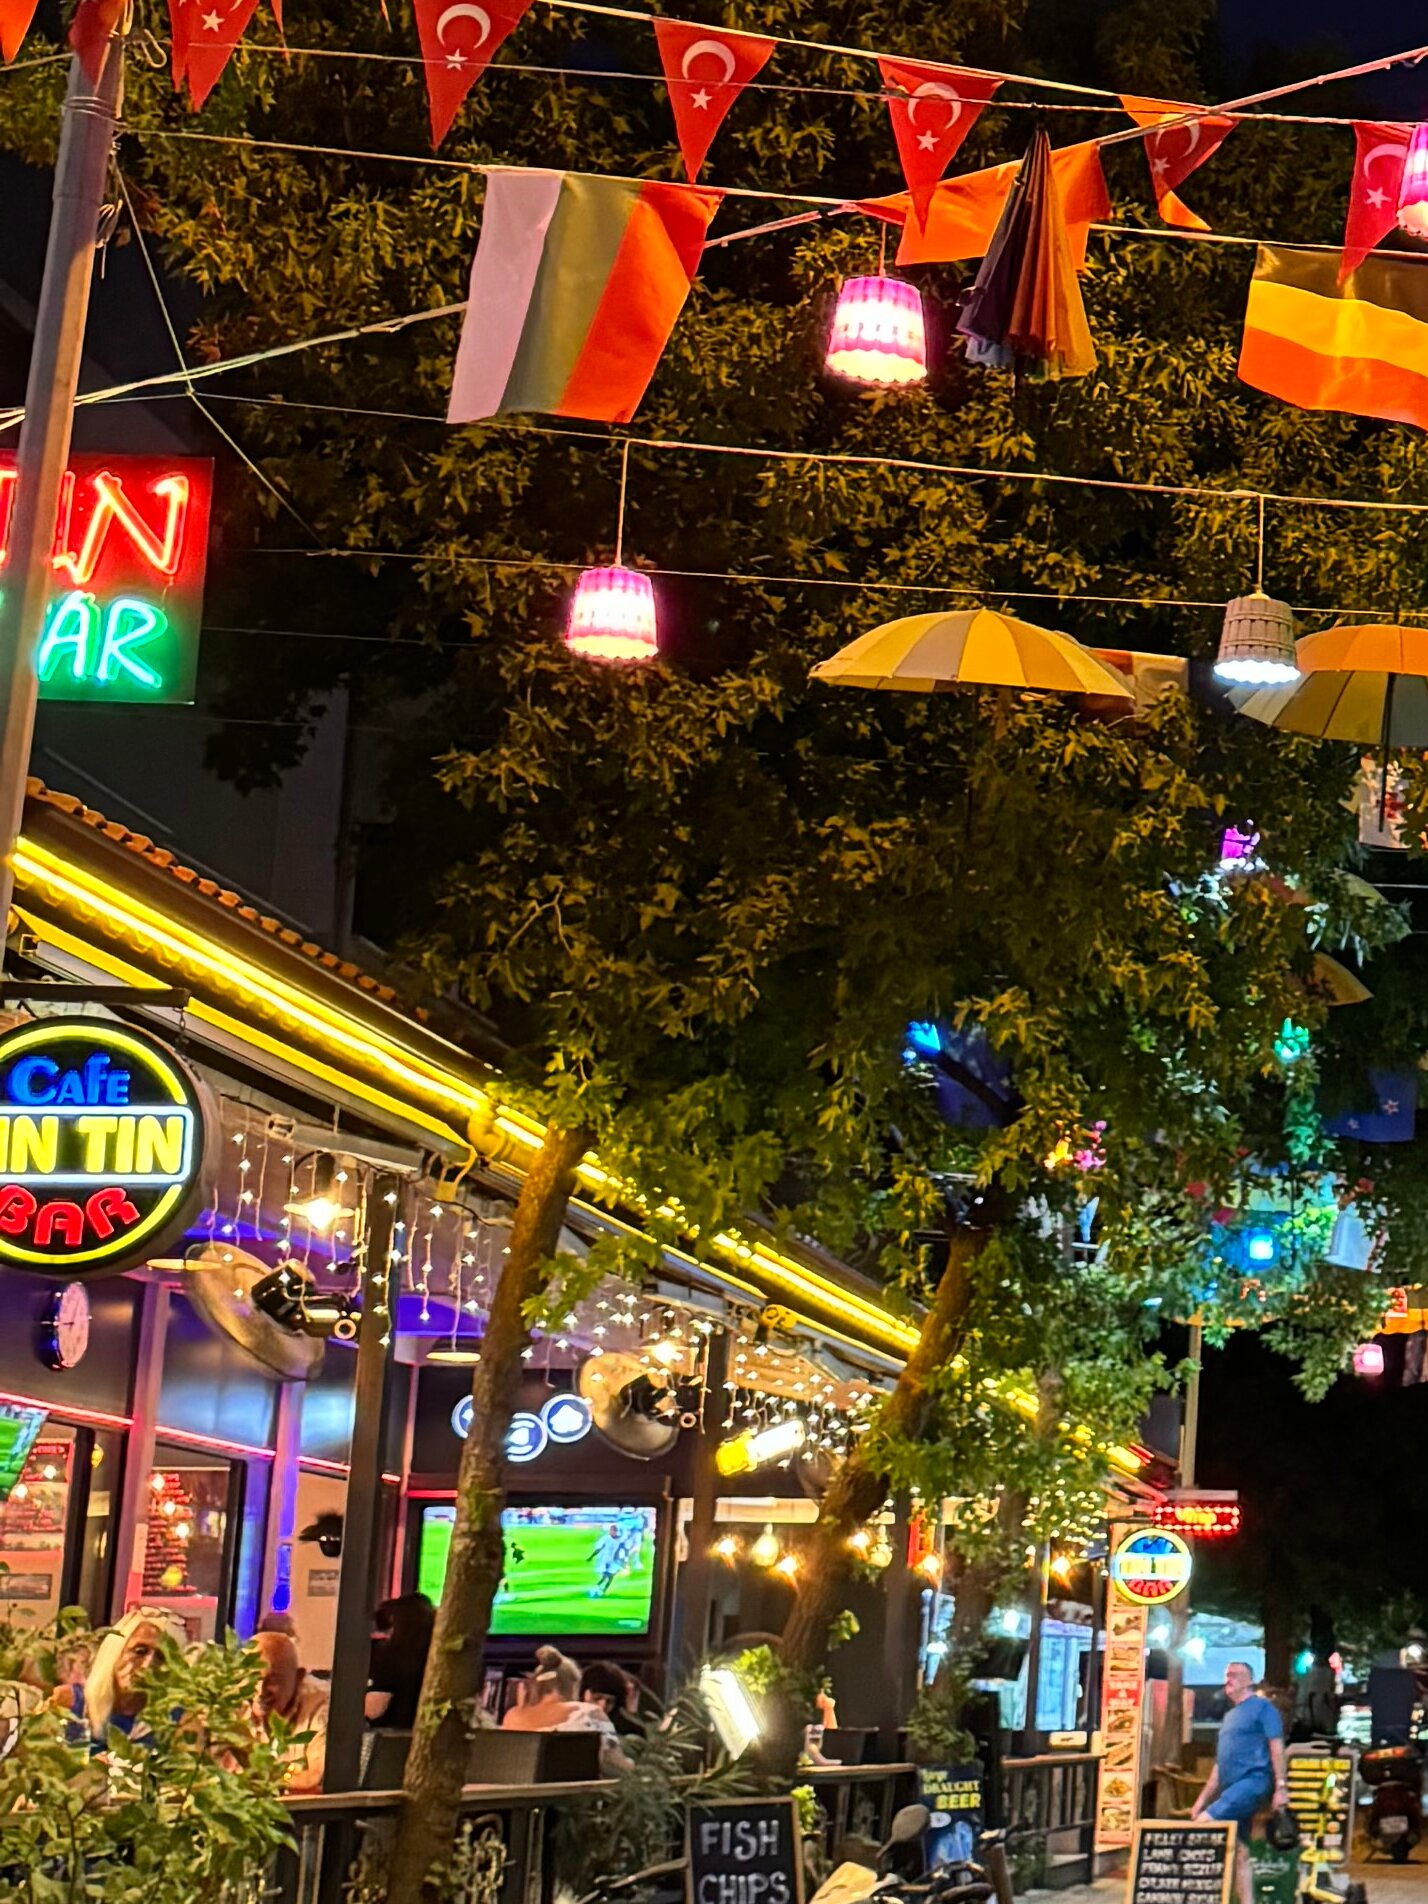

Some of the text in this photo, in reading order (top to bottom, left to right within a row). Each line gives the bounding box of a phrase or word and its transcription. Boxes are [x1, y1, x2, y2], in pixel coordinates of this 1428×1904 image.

[78, 1114, 185, 1174] TIN
[0, 1184, 141, 1246] BAR
[935, 1792, 982, 1810] BEER
[700, 1819, 780, 1862] FISH
